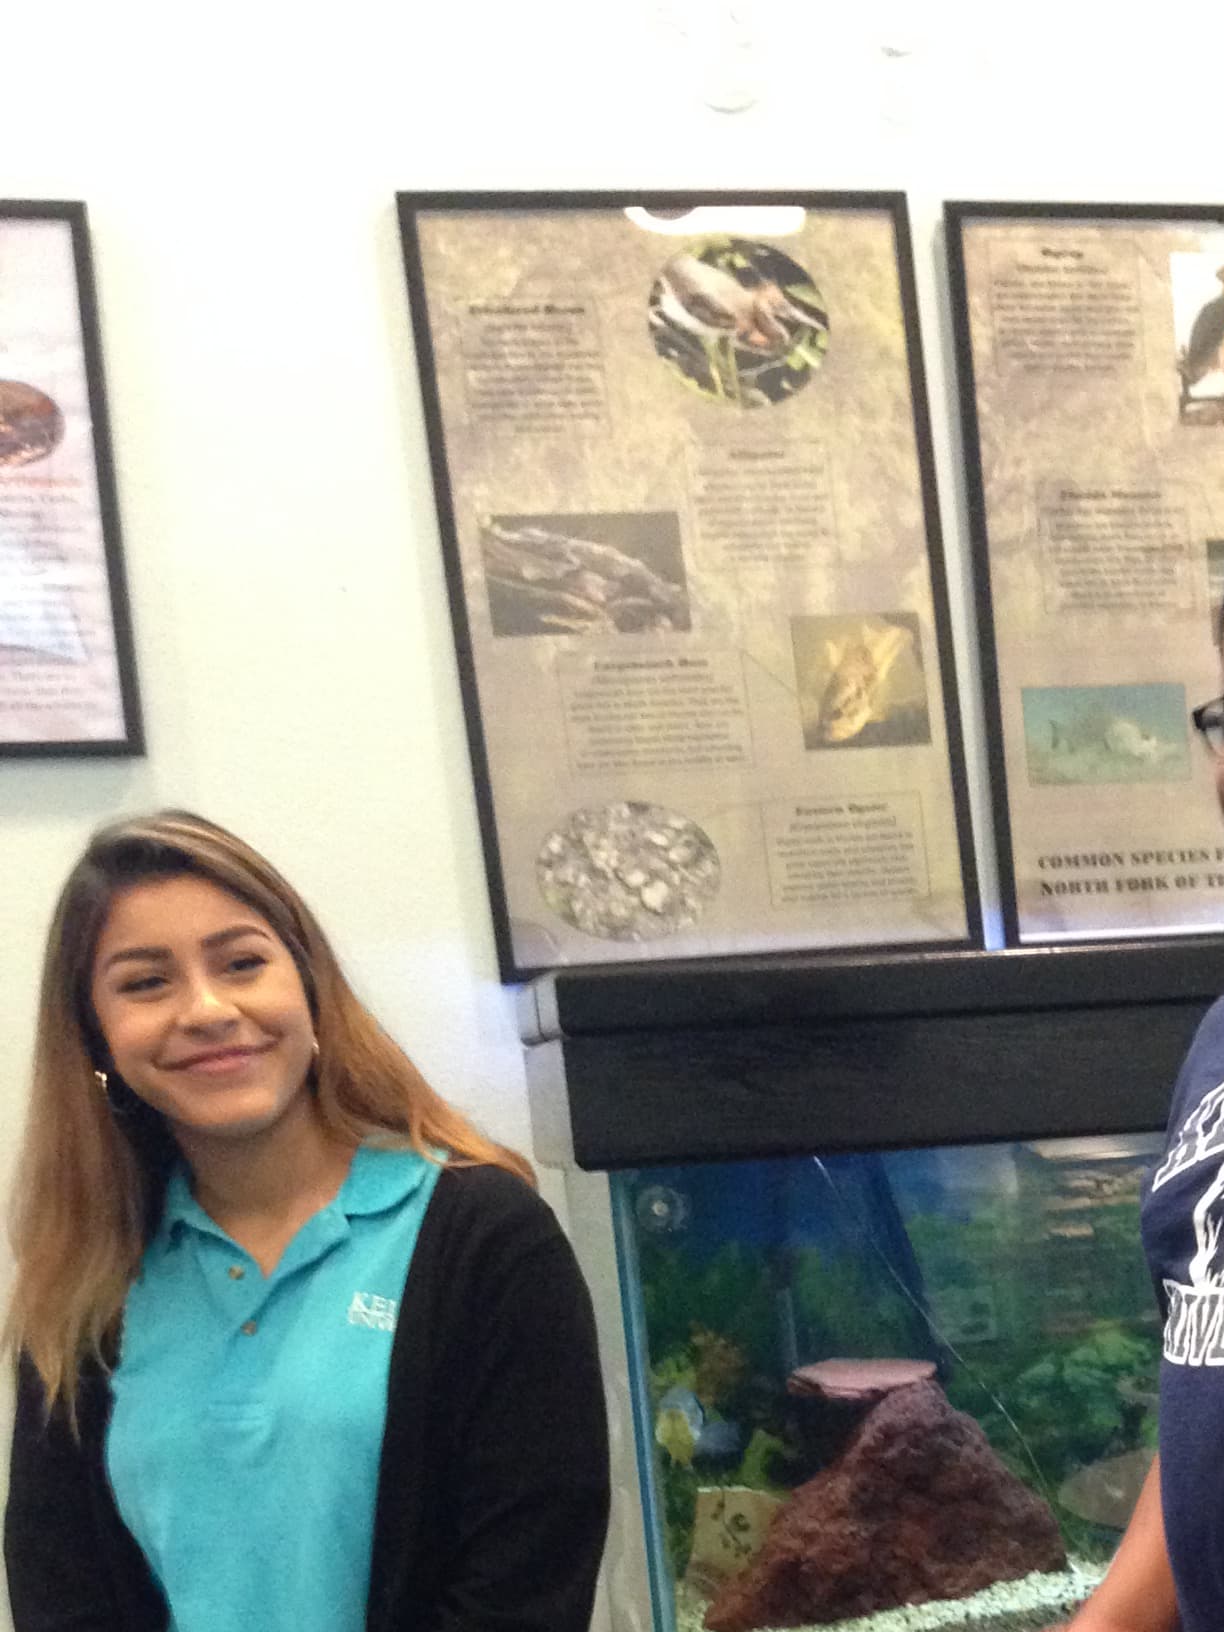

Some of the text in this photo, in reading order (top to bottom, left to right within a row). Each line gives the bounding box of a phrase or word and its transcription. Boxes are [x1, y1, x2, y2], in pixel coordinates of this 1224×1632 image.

[1038, 852, 1124, 870] COMMON
[1131, 850, 1210, 866] SPECIES
[1042, 879, 1109, 896] NORTH
[1115, 876, 1169, 892] FORK
[1174, 875, 1196, 889] OF
